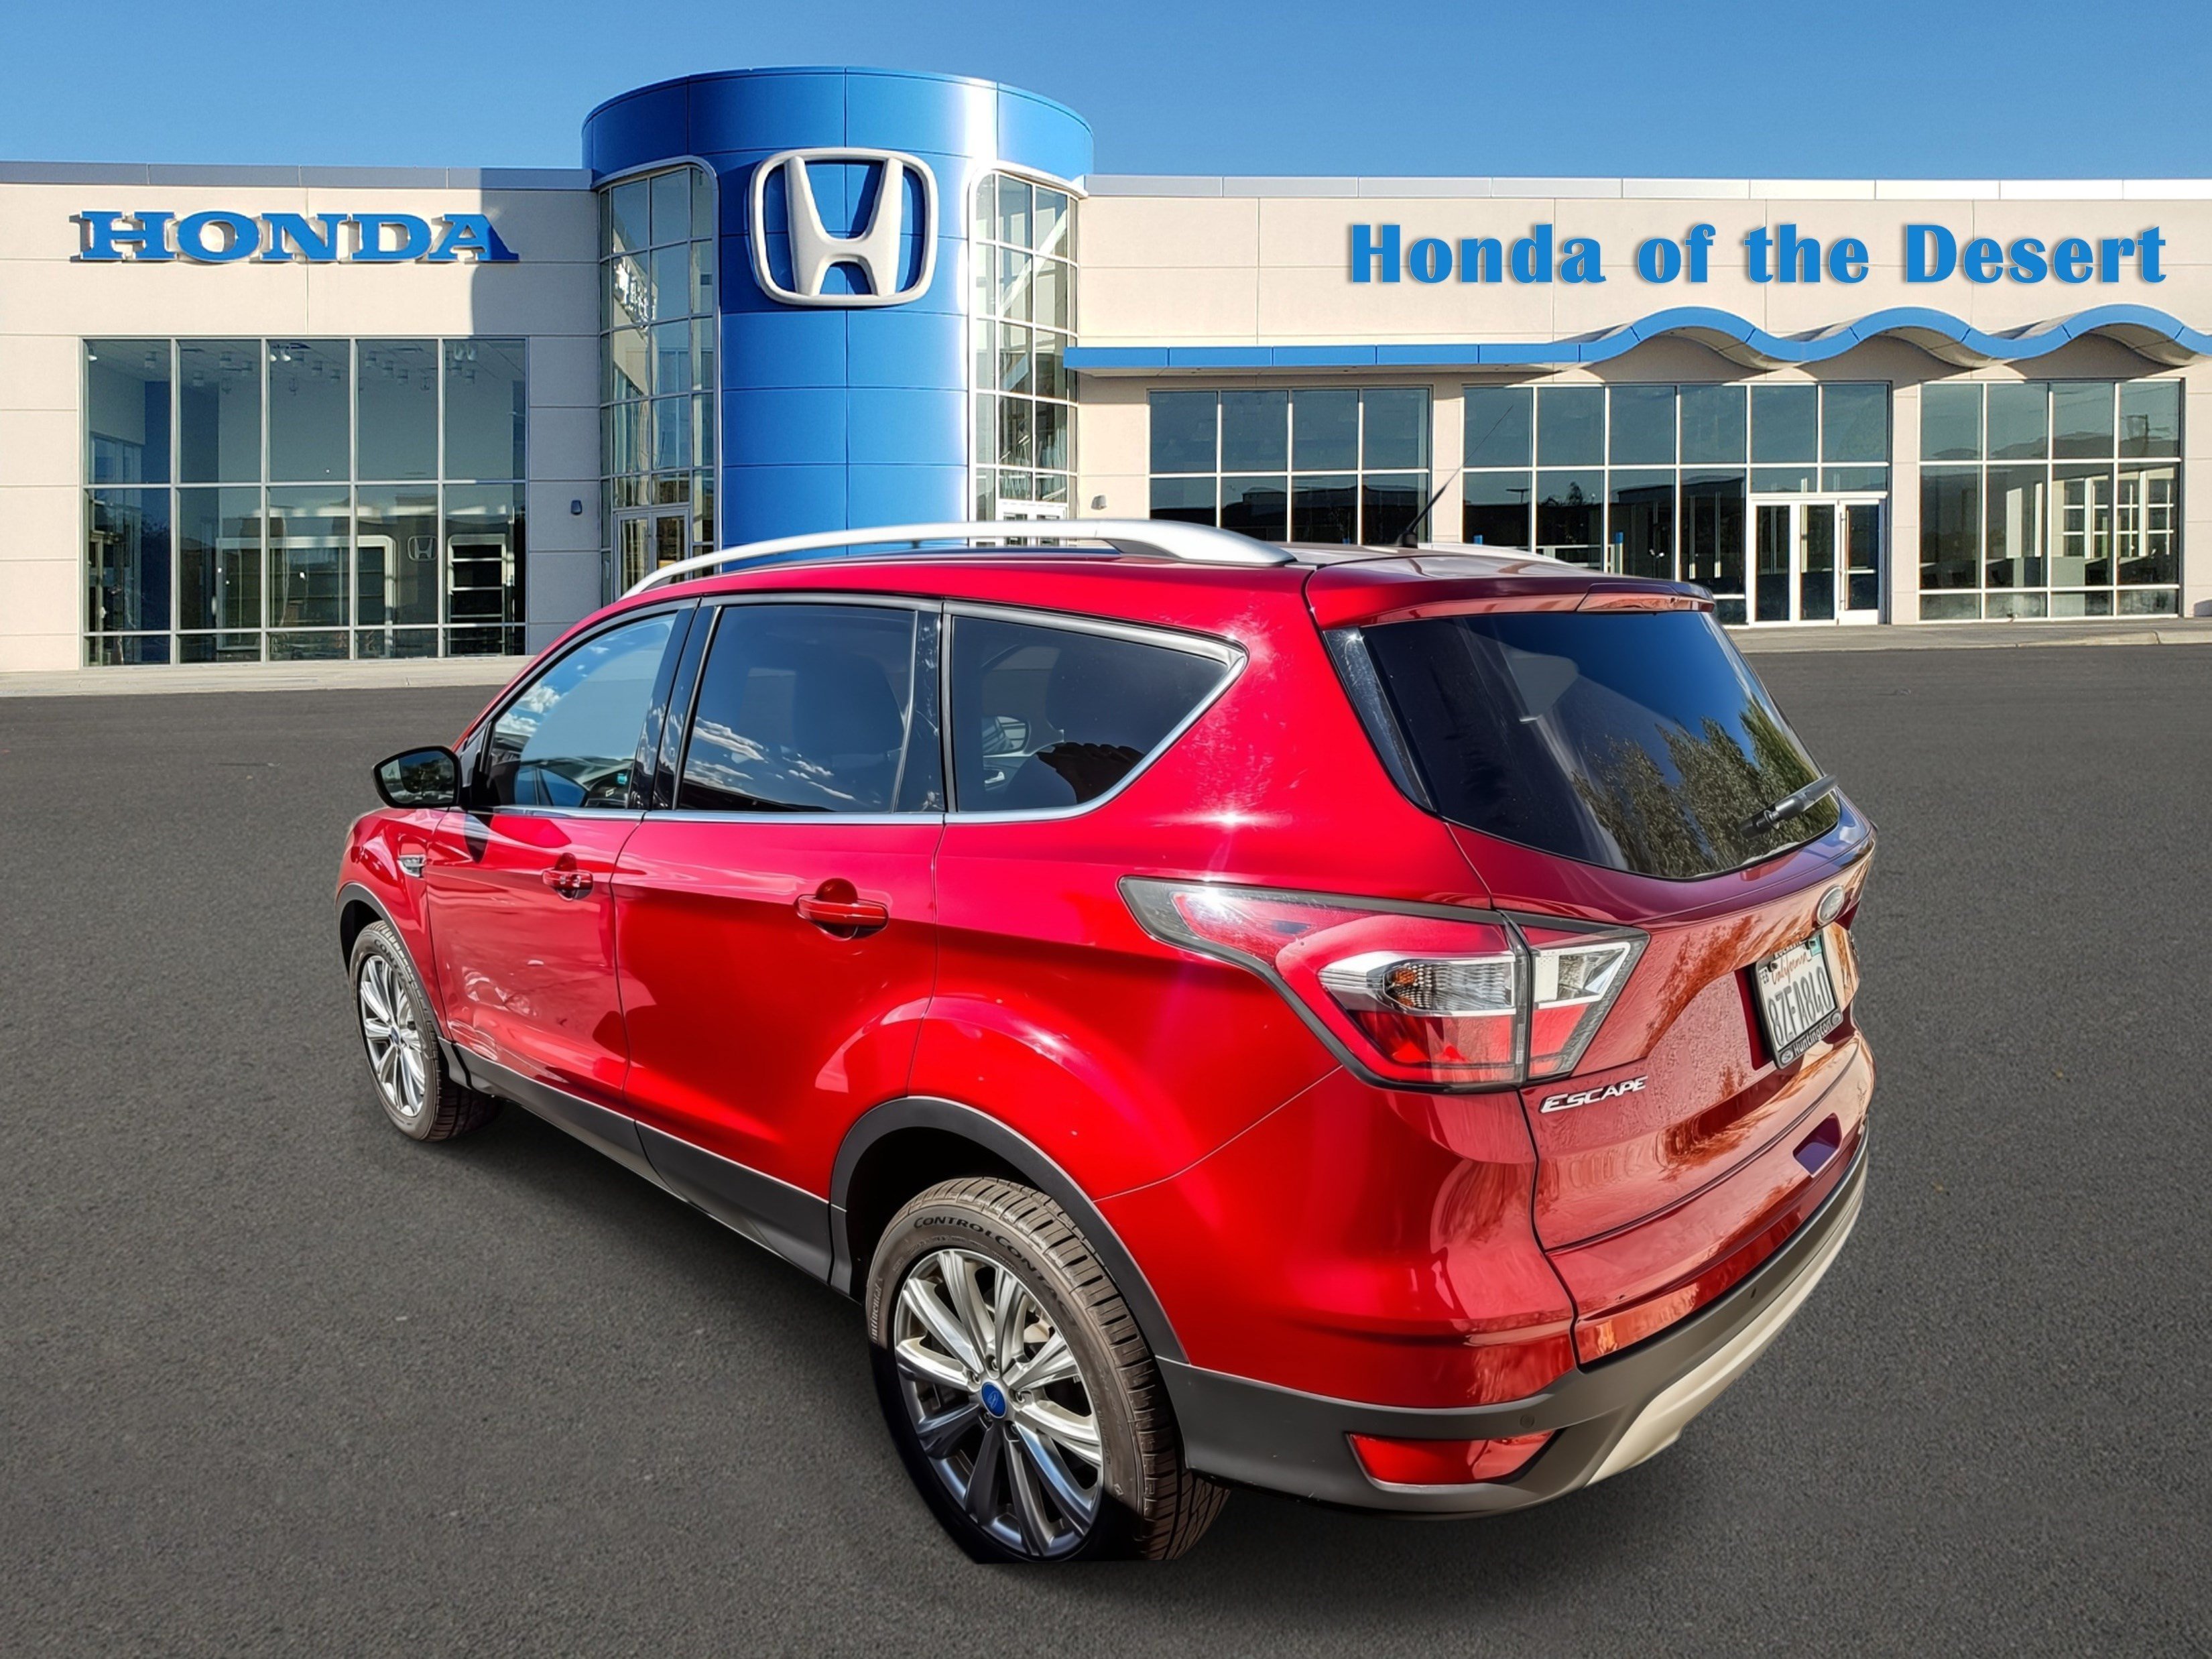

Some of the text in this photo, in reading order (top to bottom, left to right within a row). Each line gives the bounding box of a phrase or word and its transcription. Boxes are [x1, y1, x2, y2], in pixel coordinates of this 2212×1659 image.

[80, 211, 519, 261] HONDA
[1352, 223, 2167, 284] Honda of the Desert
[1767, 966, 1833, 1046] 8ZFA840
[1540, 1076, 1648, 1113] ESCAPE
